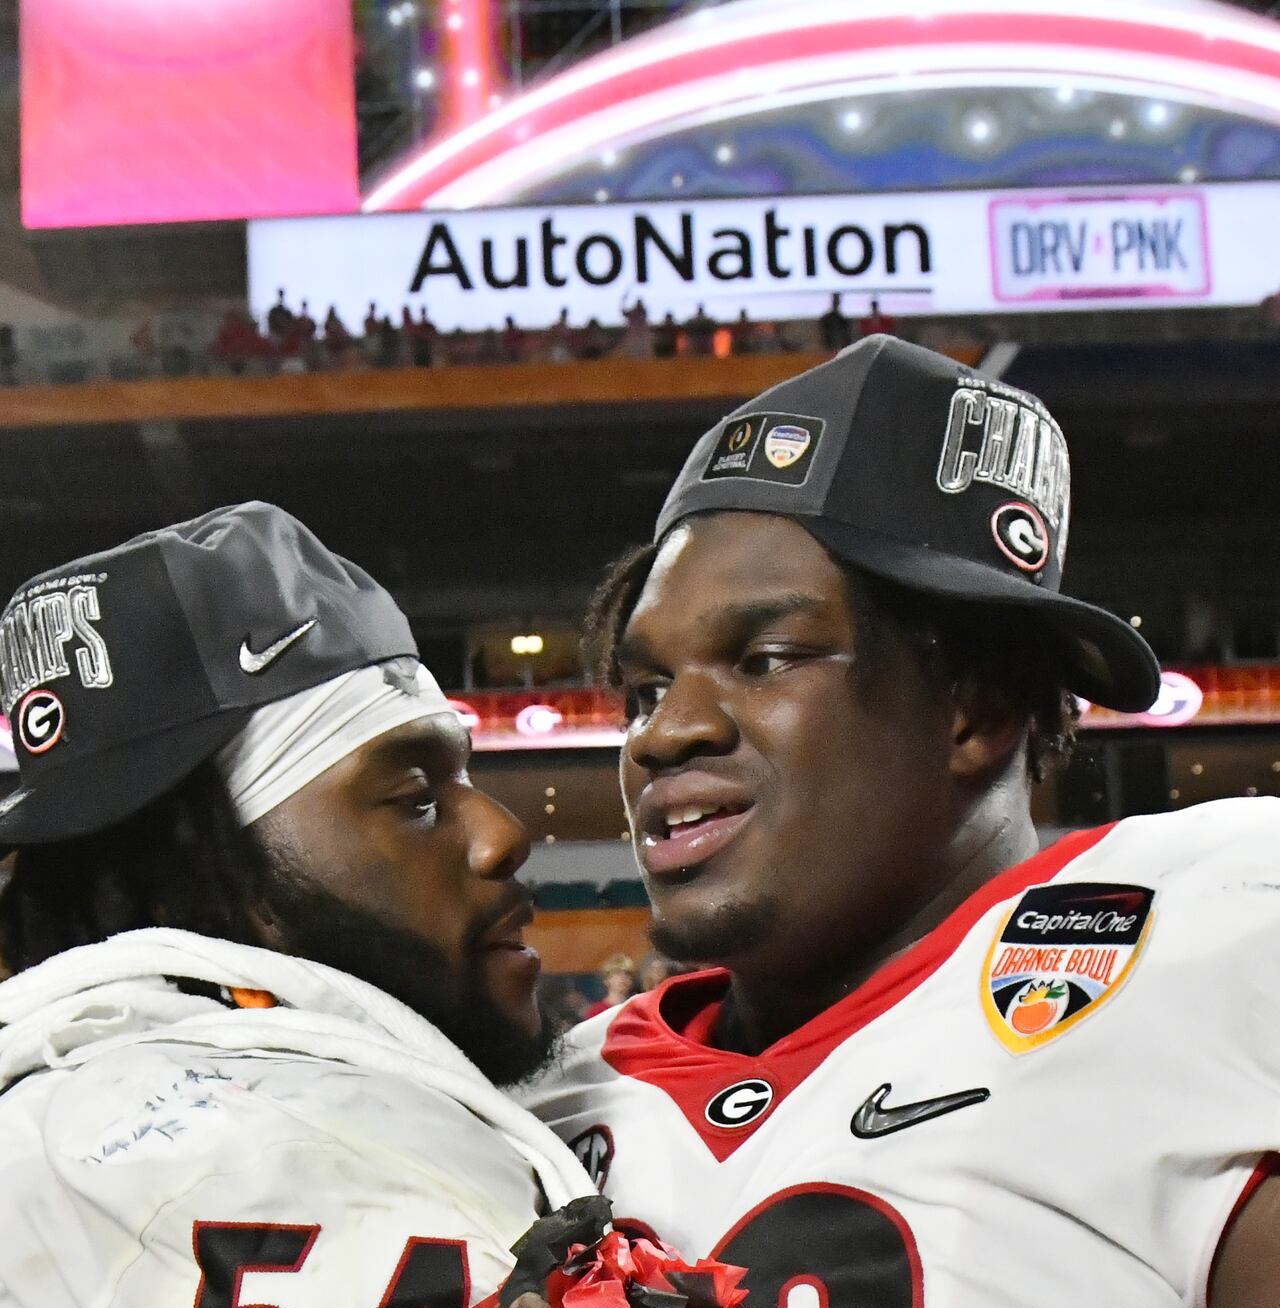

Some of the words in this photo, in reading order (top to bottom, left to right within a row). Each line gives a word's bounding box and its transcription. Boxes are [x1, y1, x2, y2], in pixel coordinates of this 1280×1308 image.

[408, 209, 931, 293] AutoNation
[1011, 221, 1087, 276] DRV
[1111, 218, 1188, 271] PNK
[991, 946, 1067, 978] ORANGE
[1065, 948, 1119, 986] BOWL
